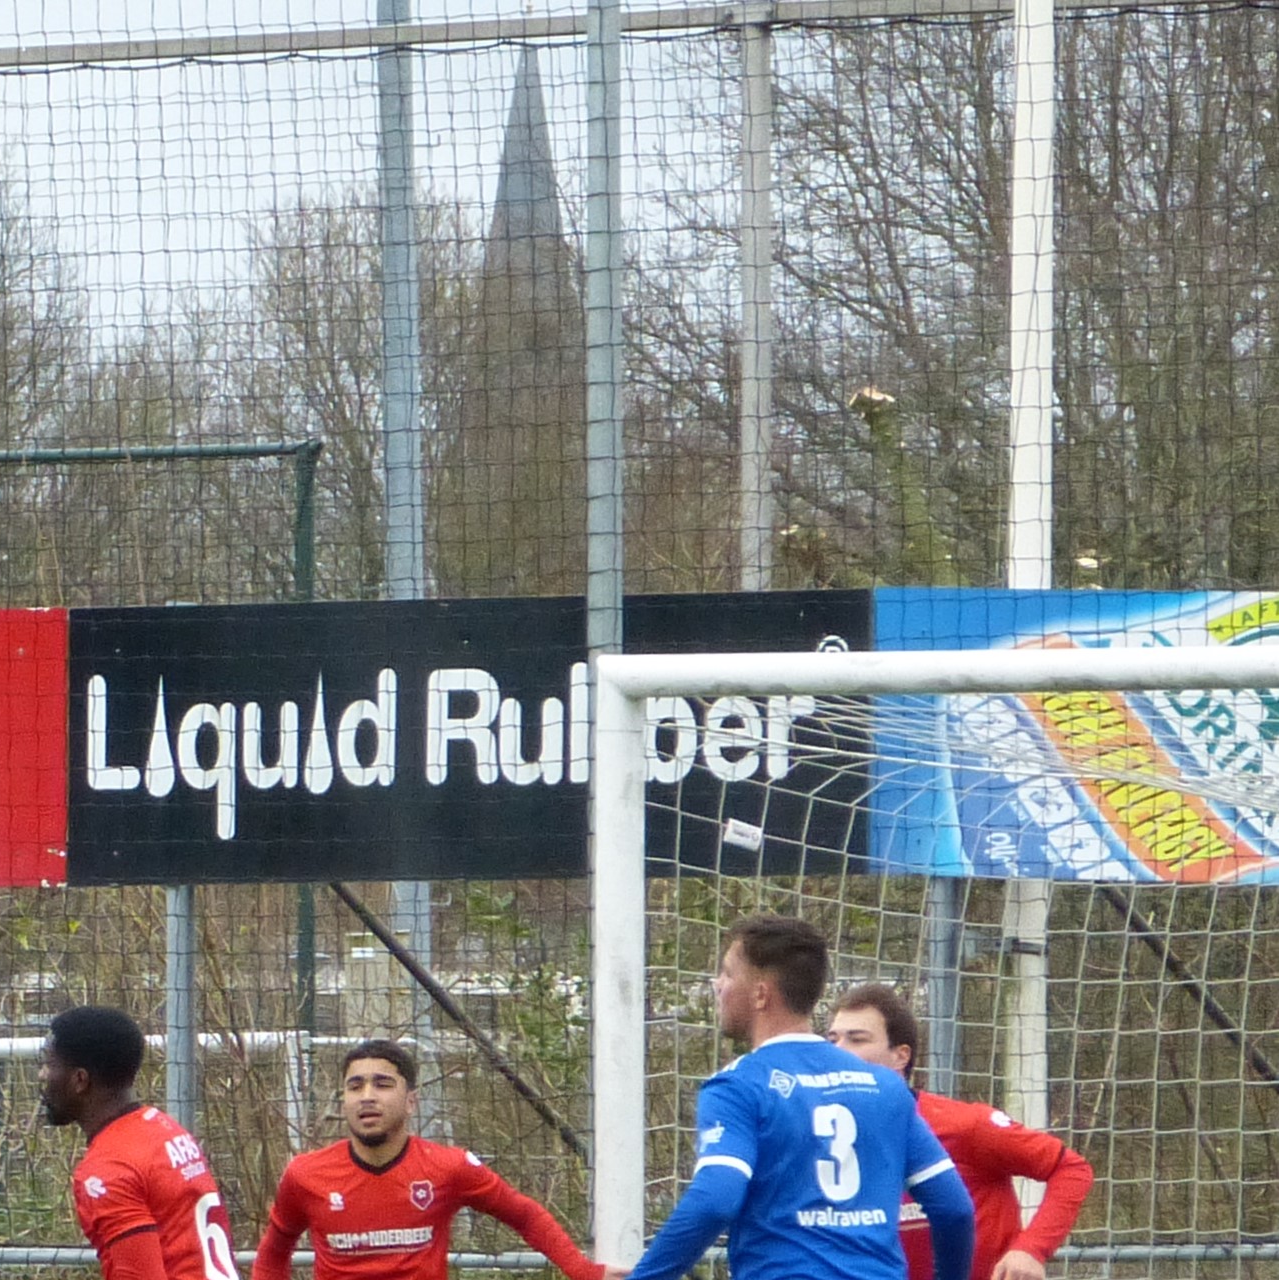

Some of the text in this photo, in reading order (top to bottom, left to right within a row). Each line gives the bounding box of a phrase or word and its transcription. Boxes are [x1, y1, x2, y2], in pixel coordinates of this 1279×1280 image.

[87, 663, 816, 840] Liquid Ruber
[813, 1103, 862, 1203] 3
[797, 1207, 887, 1227] walraven
